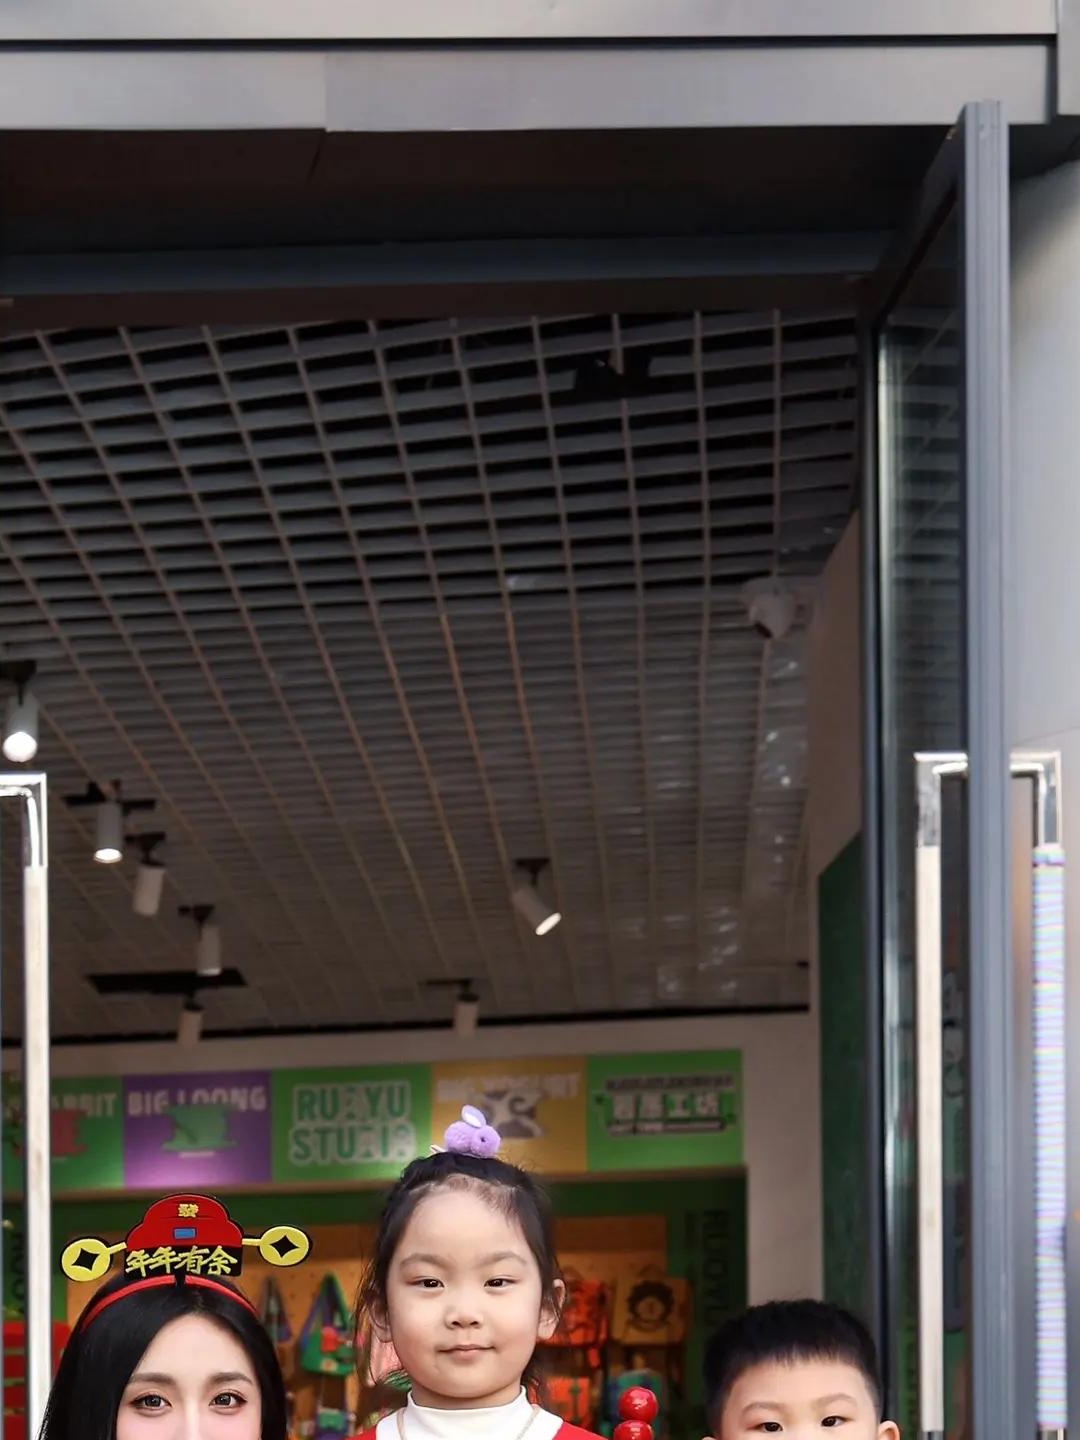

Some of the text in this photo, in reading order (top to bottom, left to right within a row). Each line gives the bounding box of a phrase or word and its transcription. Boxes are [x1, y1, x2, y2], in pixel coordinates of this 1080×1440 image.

[128, 1091, 169, 1116] BIG
[125, 1246, 238, 1278] 年年有余
